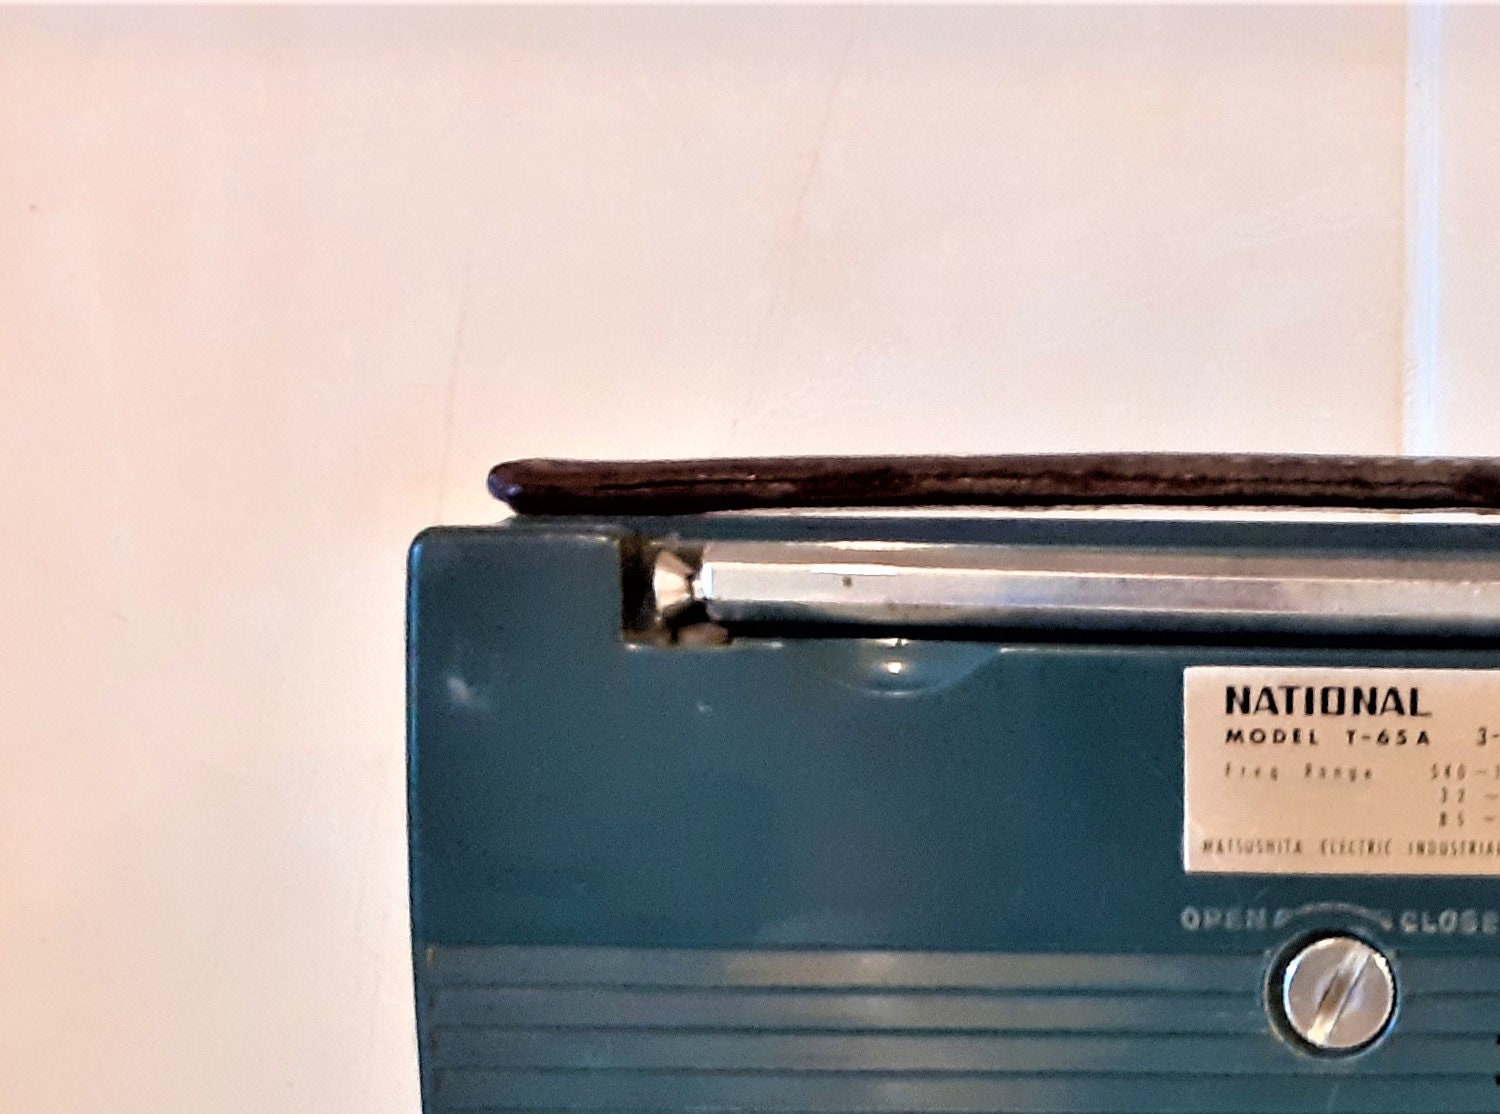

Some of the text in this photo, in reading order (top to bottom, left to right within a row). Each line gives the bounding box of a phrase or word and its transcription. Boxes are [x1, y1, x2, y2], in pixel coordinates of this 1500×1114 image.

[1225, 686, 1432, 716] NATIONAL
[1225, 728, 1431, 746] MODEL T-65A
[1202, 838, 1303, 855] MATSUSHITA
[1320, 838, 1393, 856] ELECTRIC
[1179, 905, 1268, 932] OPEN
[1399, 908, 1500, 936] CLOSE
